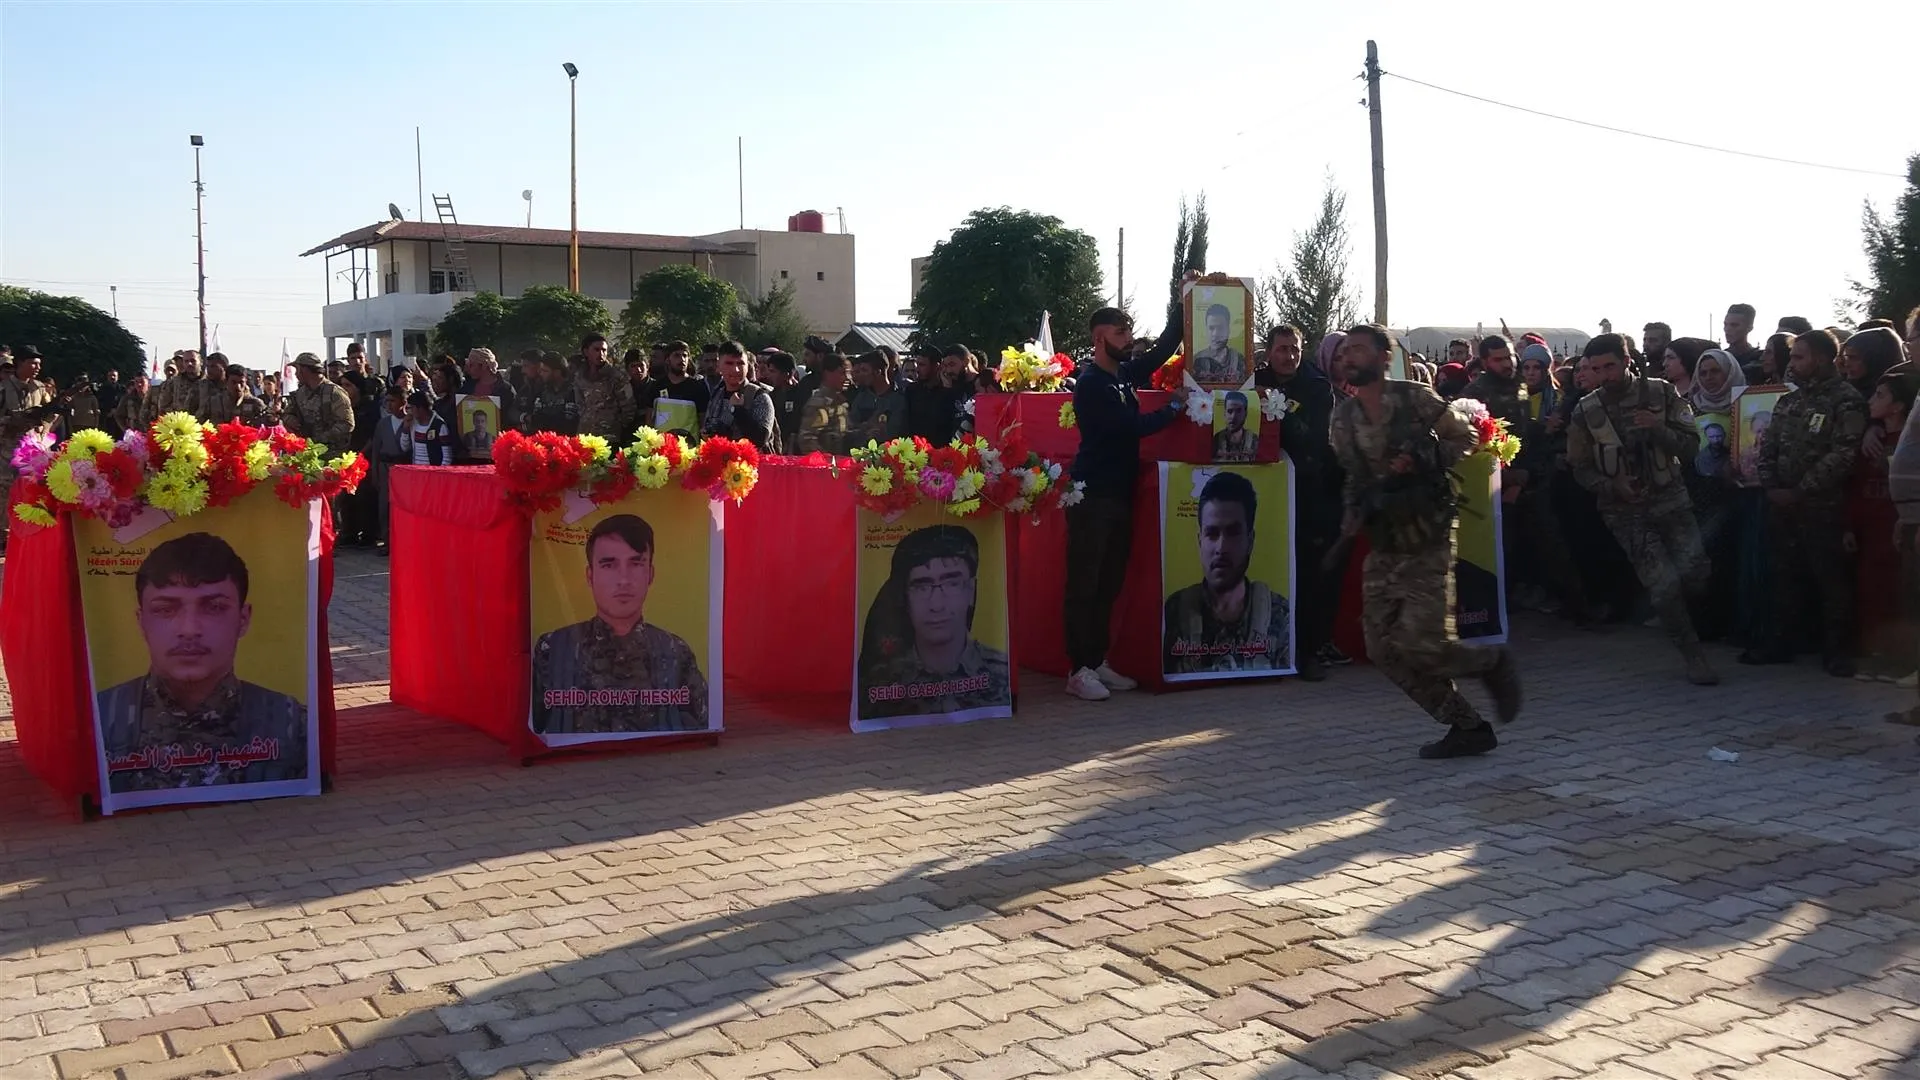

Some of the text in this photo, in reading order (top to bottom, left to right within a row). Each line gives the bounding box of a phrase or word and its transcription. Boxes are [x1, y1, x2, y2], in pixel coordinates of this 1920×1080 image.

[544, 685, 690, 709] ŞEHÎD ROHAT HESKÊ
[908, 679, 951, 698] GABAR
[215, 736, 280, 770] الشهيد
